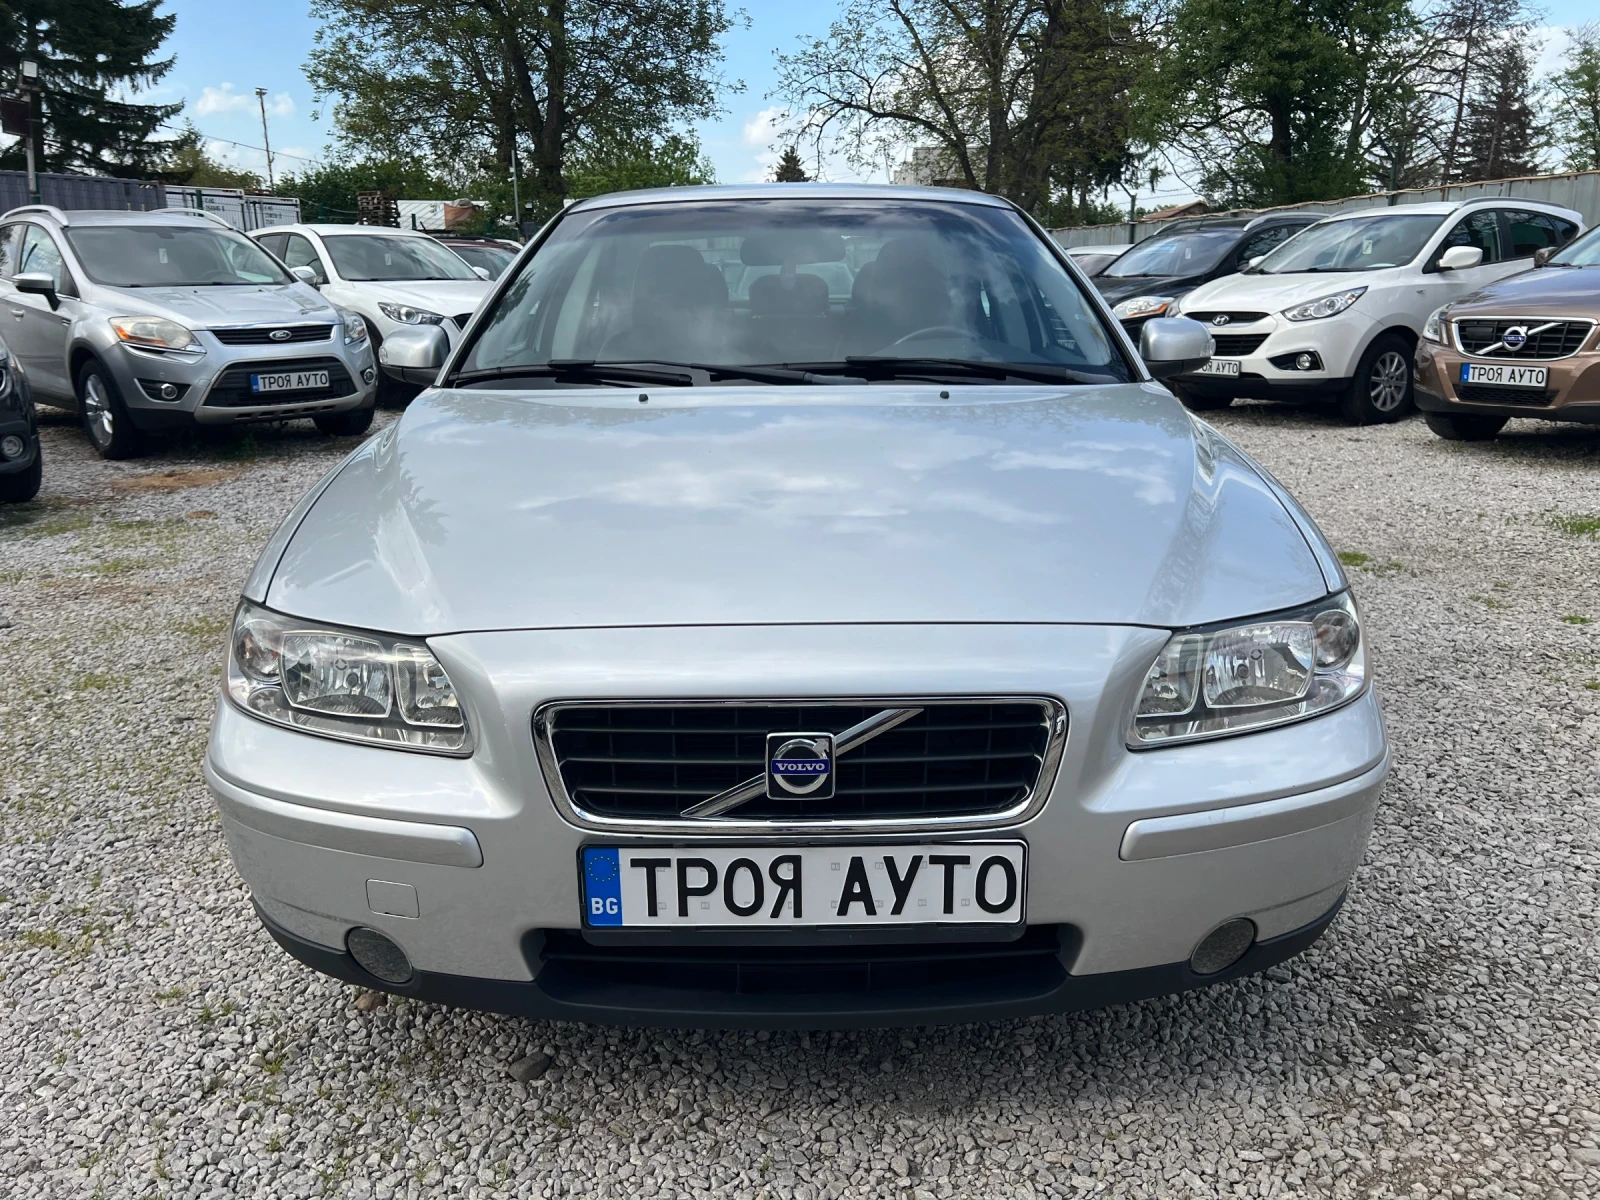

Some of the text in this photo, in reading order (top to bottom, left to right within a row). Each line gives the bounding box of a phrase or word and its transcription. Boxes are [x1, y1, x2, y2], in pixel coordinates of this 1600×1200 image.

[1216, 362, 1238, 374] АУТО
[1471, 367, 1545, 384] ТРОЯ АУТО
[260, 373, 328, 389] ТРОЯ АУТО
[775, 762, 825, 771] VOLVO
[630, 855, 1017, 918] ТРОЯ АУТО
[591, 897, 618, 915] BG
